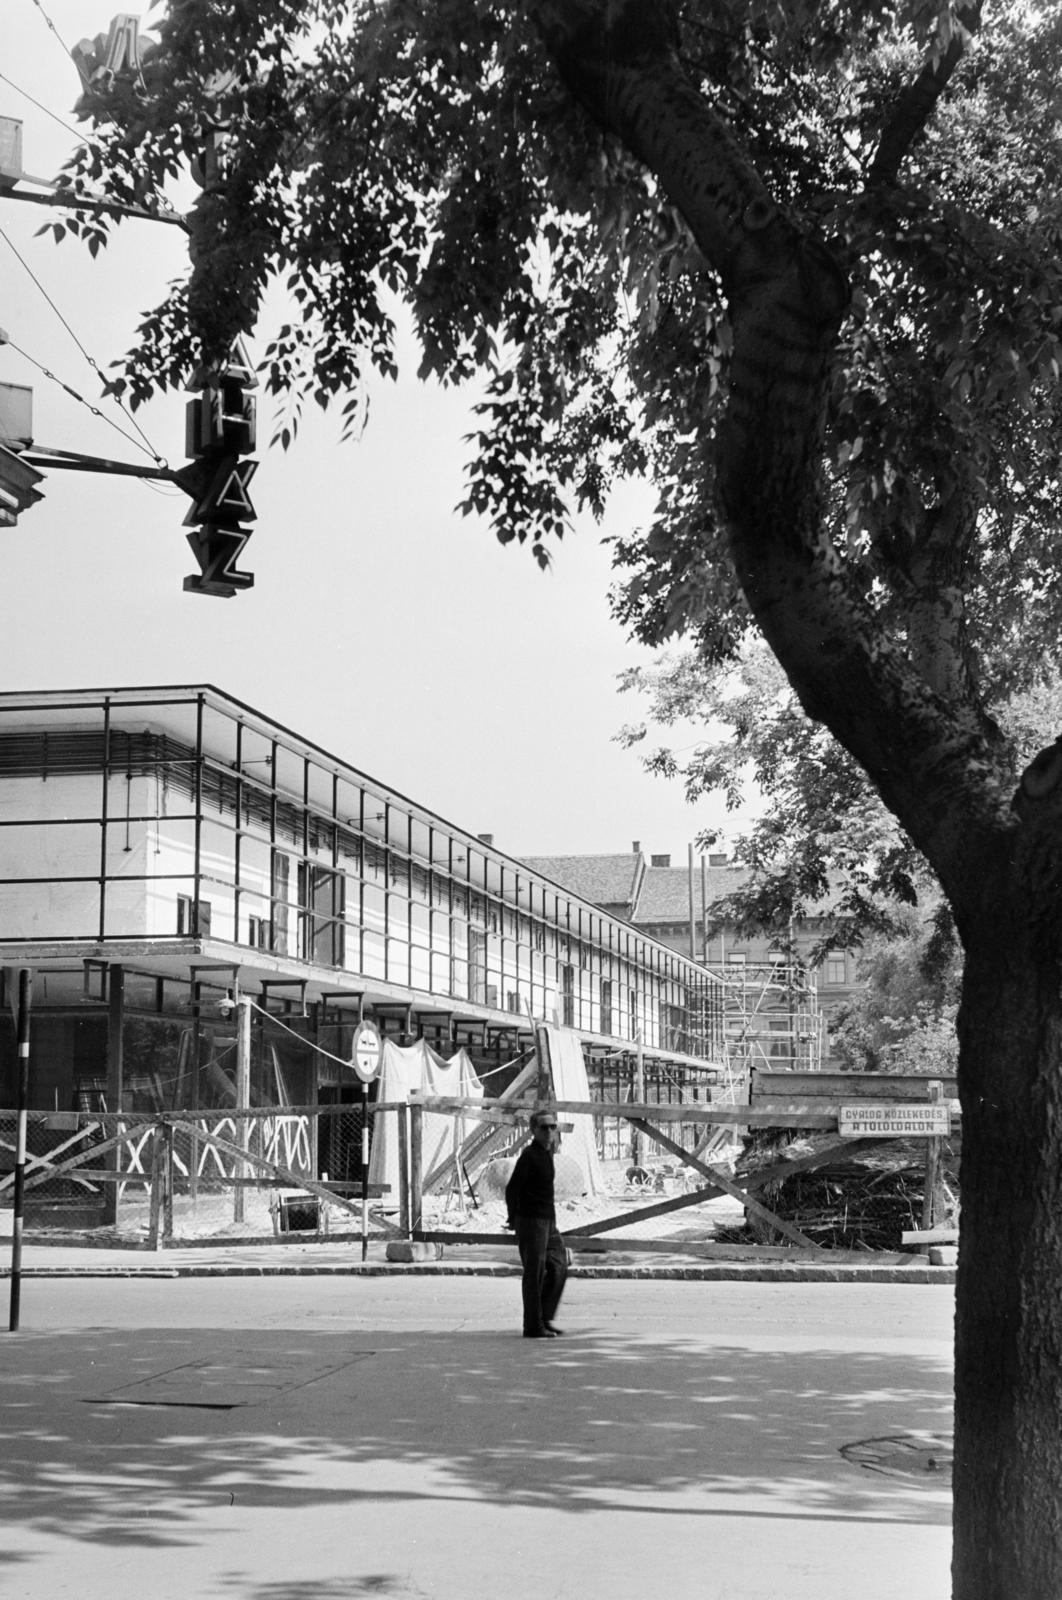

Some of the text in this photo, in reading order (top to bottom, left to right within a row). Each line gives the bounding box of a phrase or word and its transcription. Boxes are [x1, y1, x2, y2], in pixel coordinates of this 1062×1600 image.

[845, 1108, 943, 1120] GYALOG KÖZLEKEDÉS
[853, 1121, 860, 1131] A
